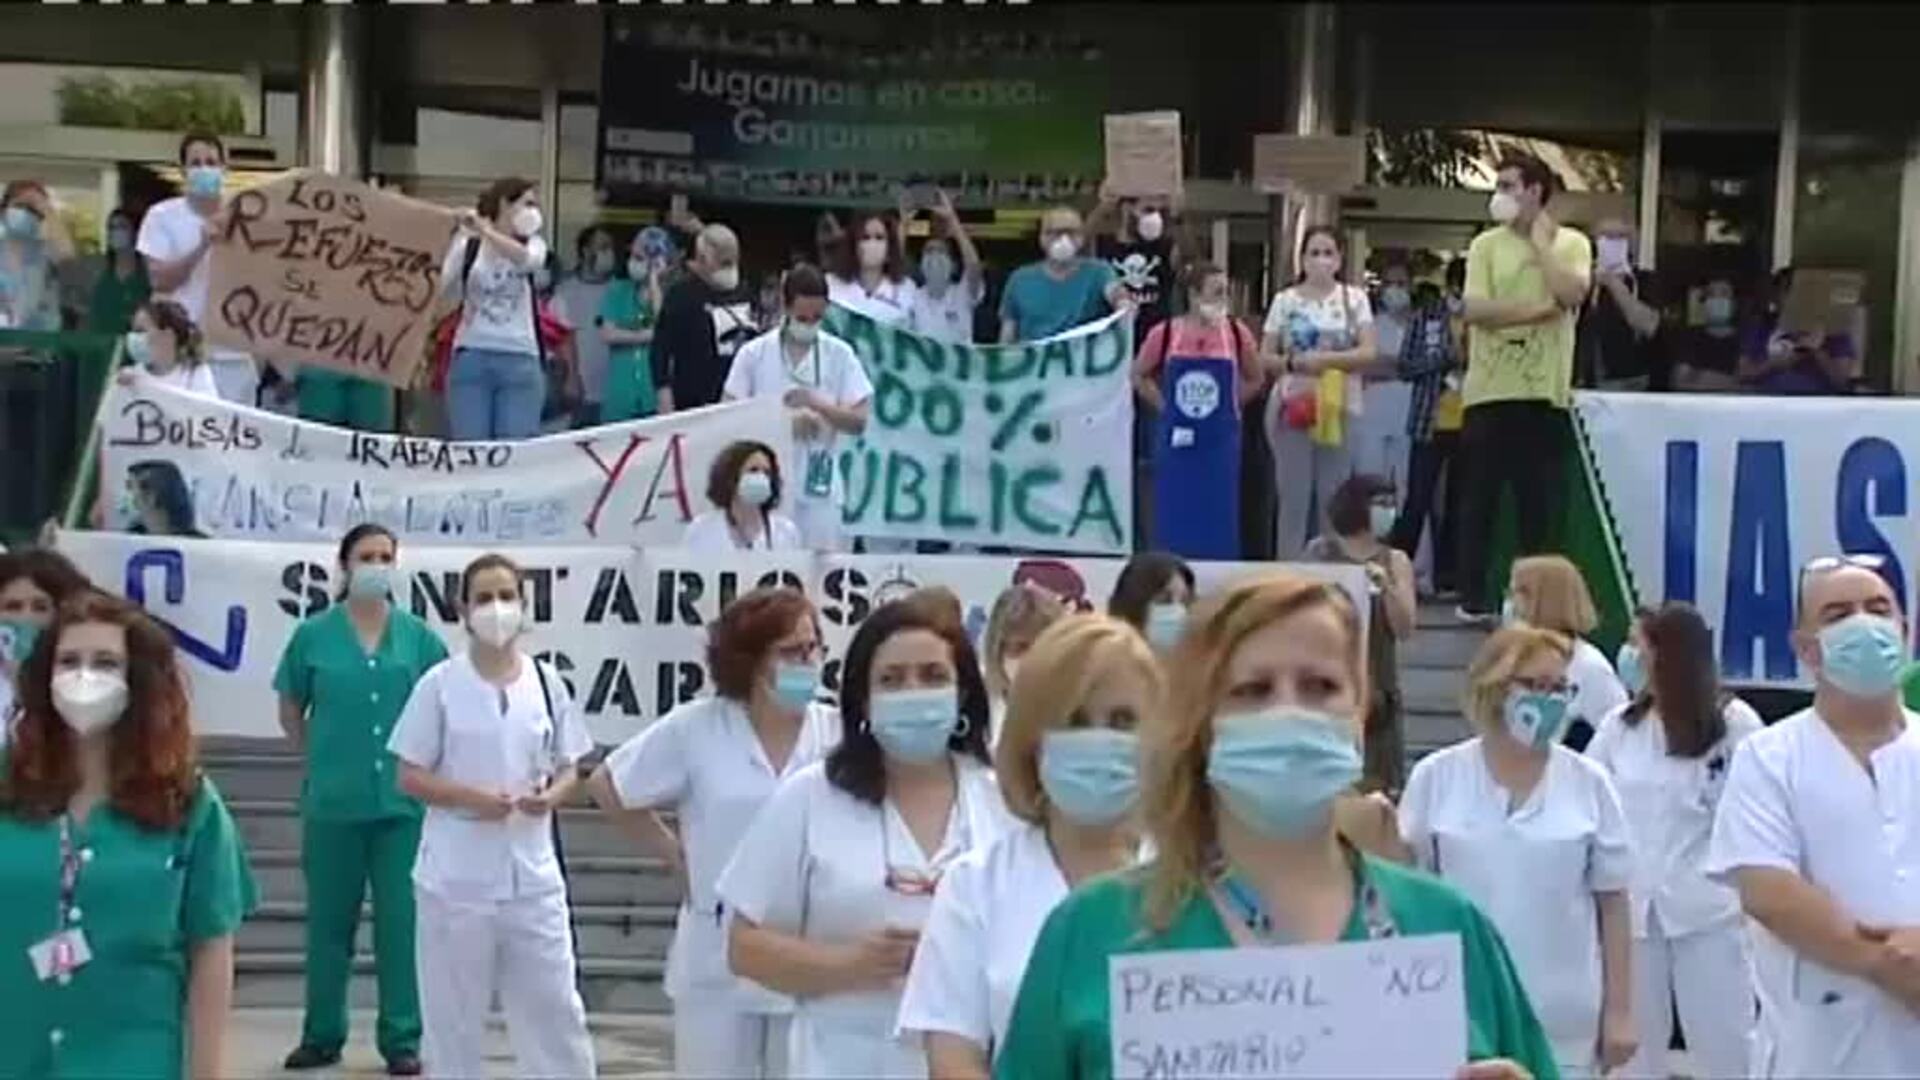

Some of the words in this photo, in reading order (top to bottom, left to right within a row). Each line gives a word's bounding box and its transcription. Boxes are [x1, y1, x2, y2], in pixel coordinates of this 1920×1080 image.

[287, 180, 365, 222] LOS
[221, 285, 414, 371] QUEDAN
[818, 300, 1128, 383] ANIDAD
[575, 433, 694, 538] YA
[838, 438, 1124, 547] ÚBLICA
[1121, 967, 1327, 1013] PERSONAL
